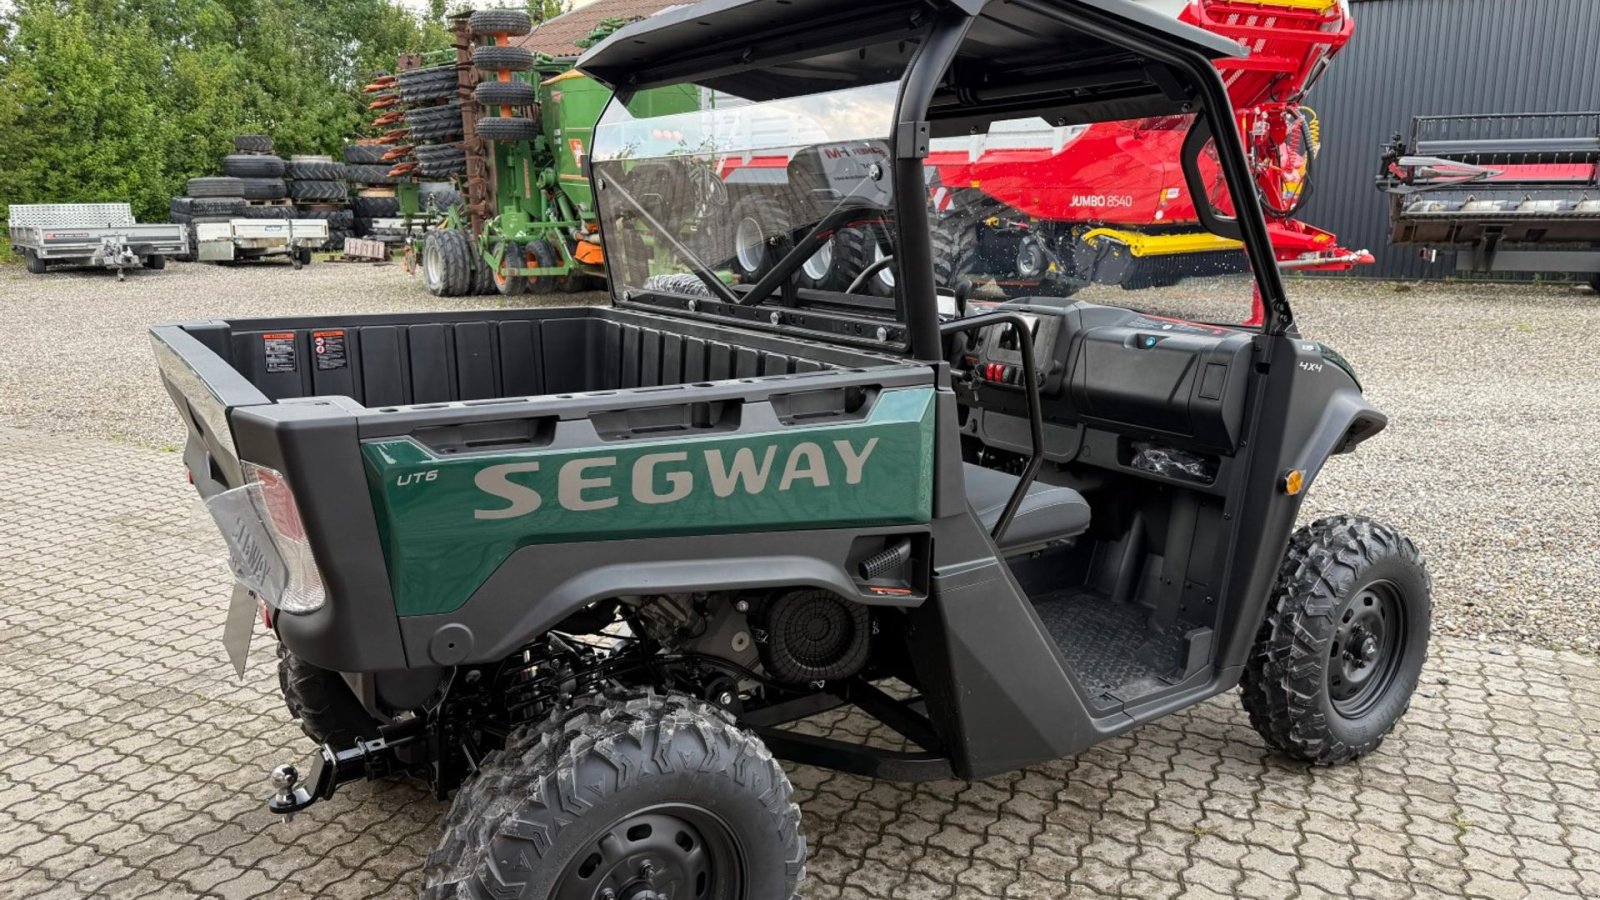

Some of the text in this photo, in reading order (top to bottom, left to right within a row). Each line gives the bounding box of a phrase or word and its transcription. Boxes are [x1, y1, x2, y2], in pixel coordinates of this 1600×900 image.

[1069, 194, 1132, 207] JUMBO 8540
[396, 469, 439, 486] UT6
[474, 437, 880, 520] SEGWAY
